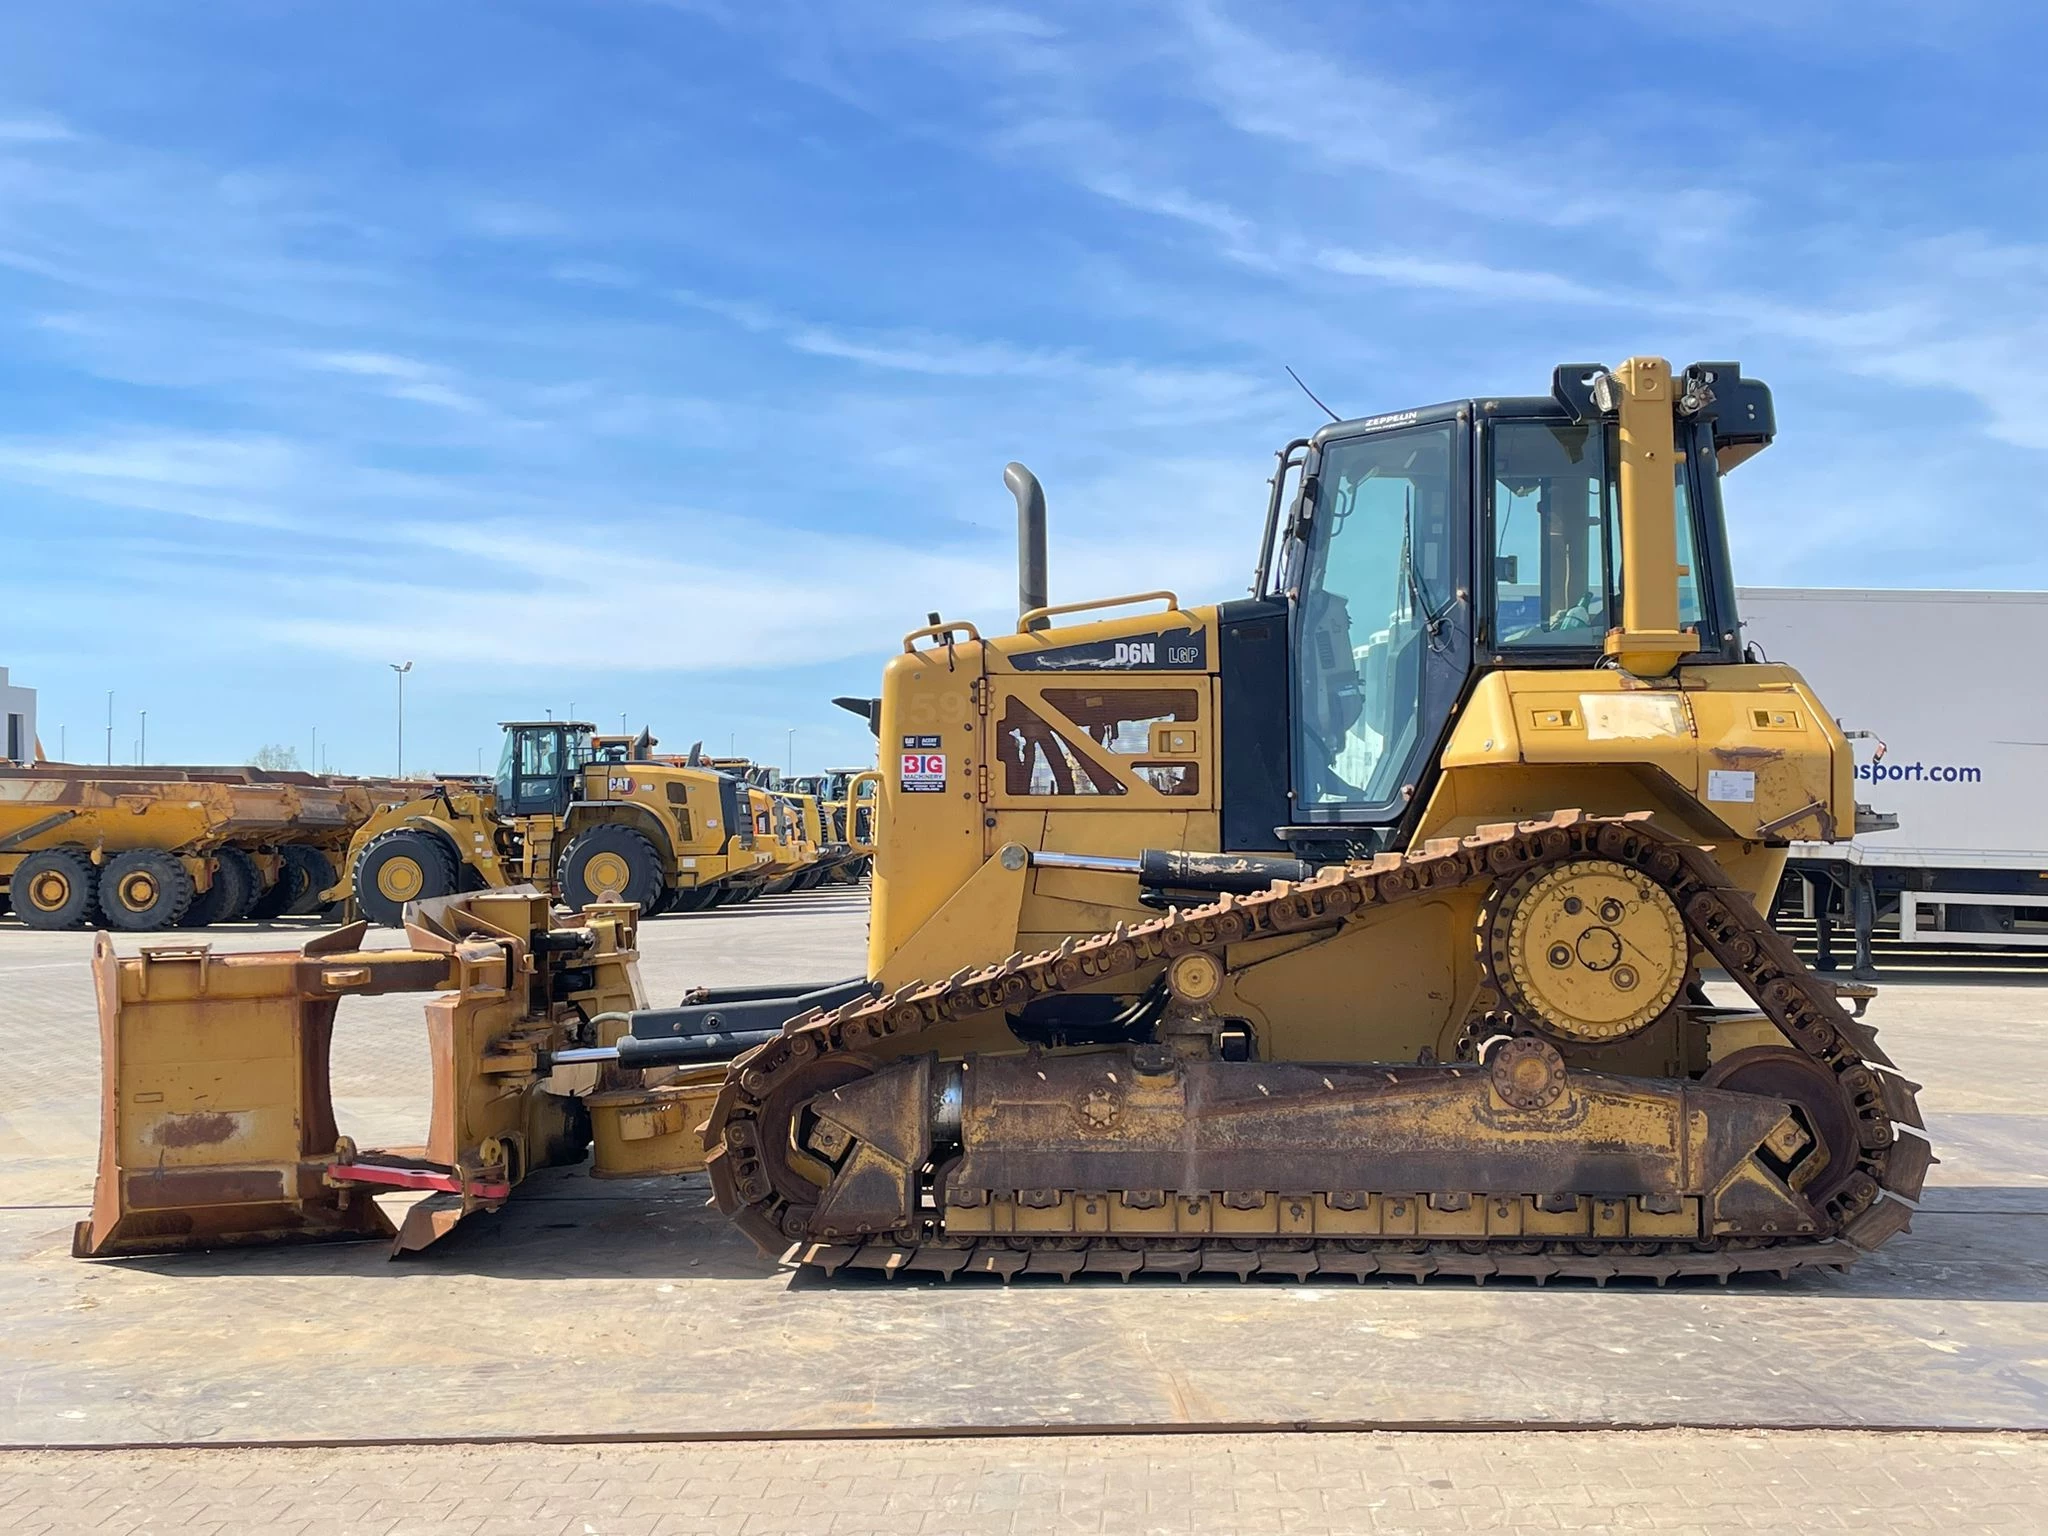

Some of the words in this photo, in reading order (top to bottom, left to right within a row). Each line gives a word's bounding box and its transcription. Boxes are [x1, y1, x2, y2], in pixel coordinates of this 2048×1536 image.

[1365, 411, 1417, 427] ZEPPELIN
[1115, 643, 1155, 664] D6N
[1168, 647, 1199, 664] LGP
[904, 755, 943, 773] BIG
[609, 777, 631, 791] CAT
